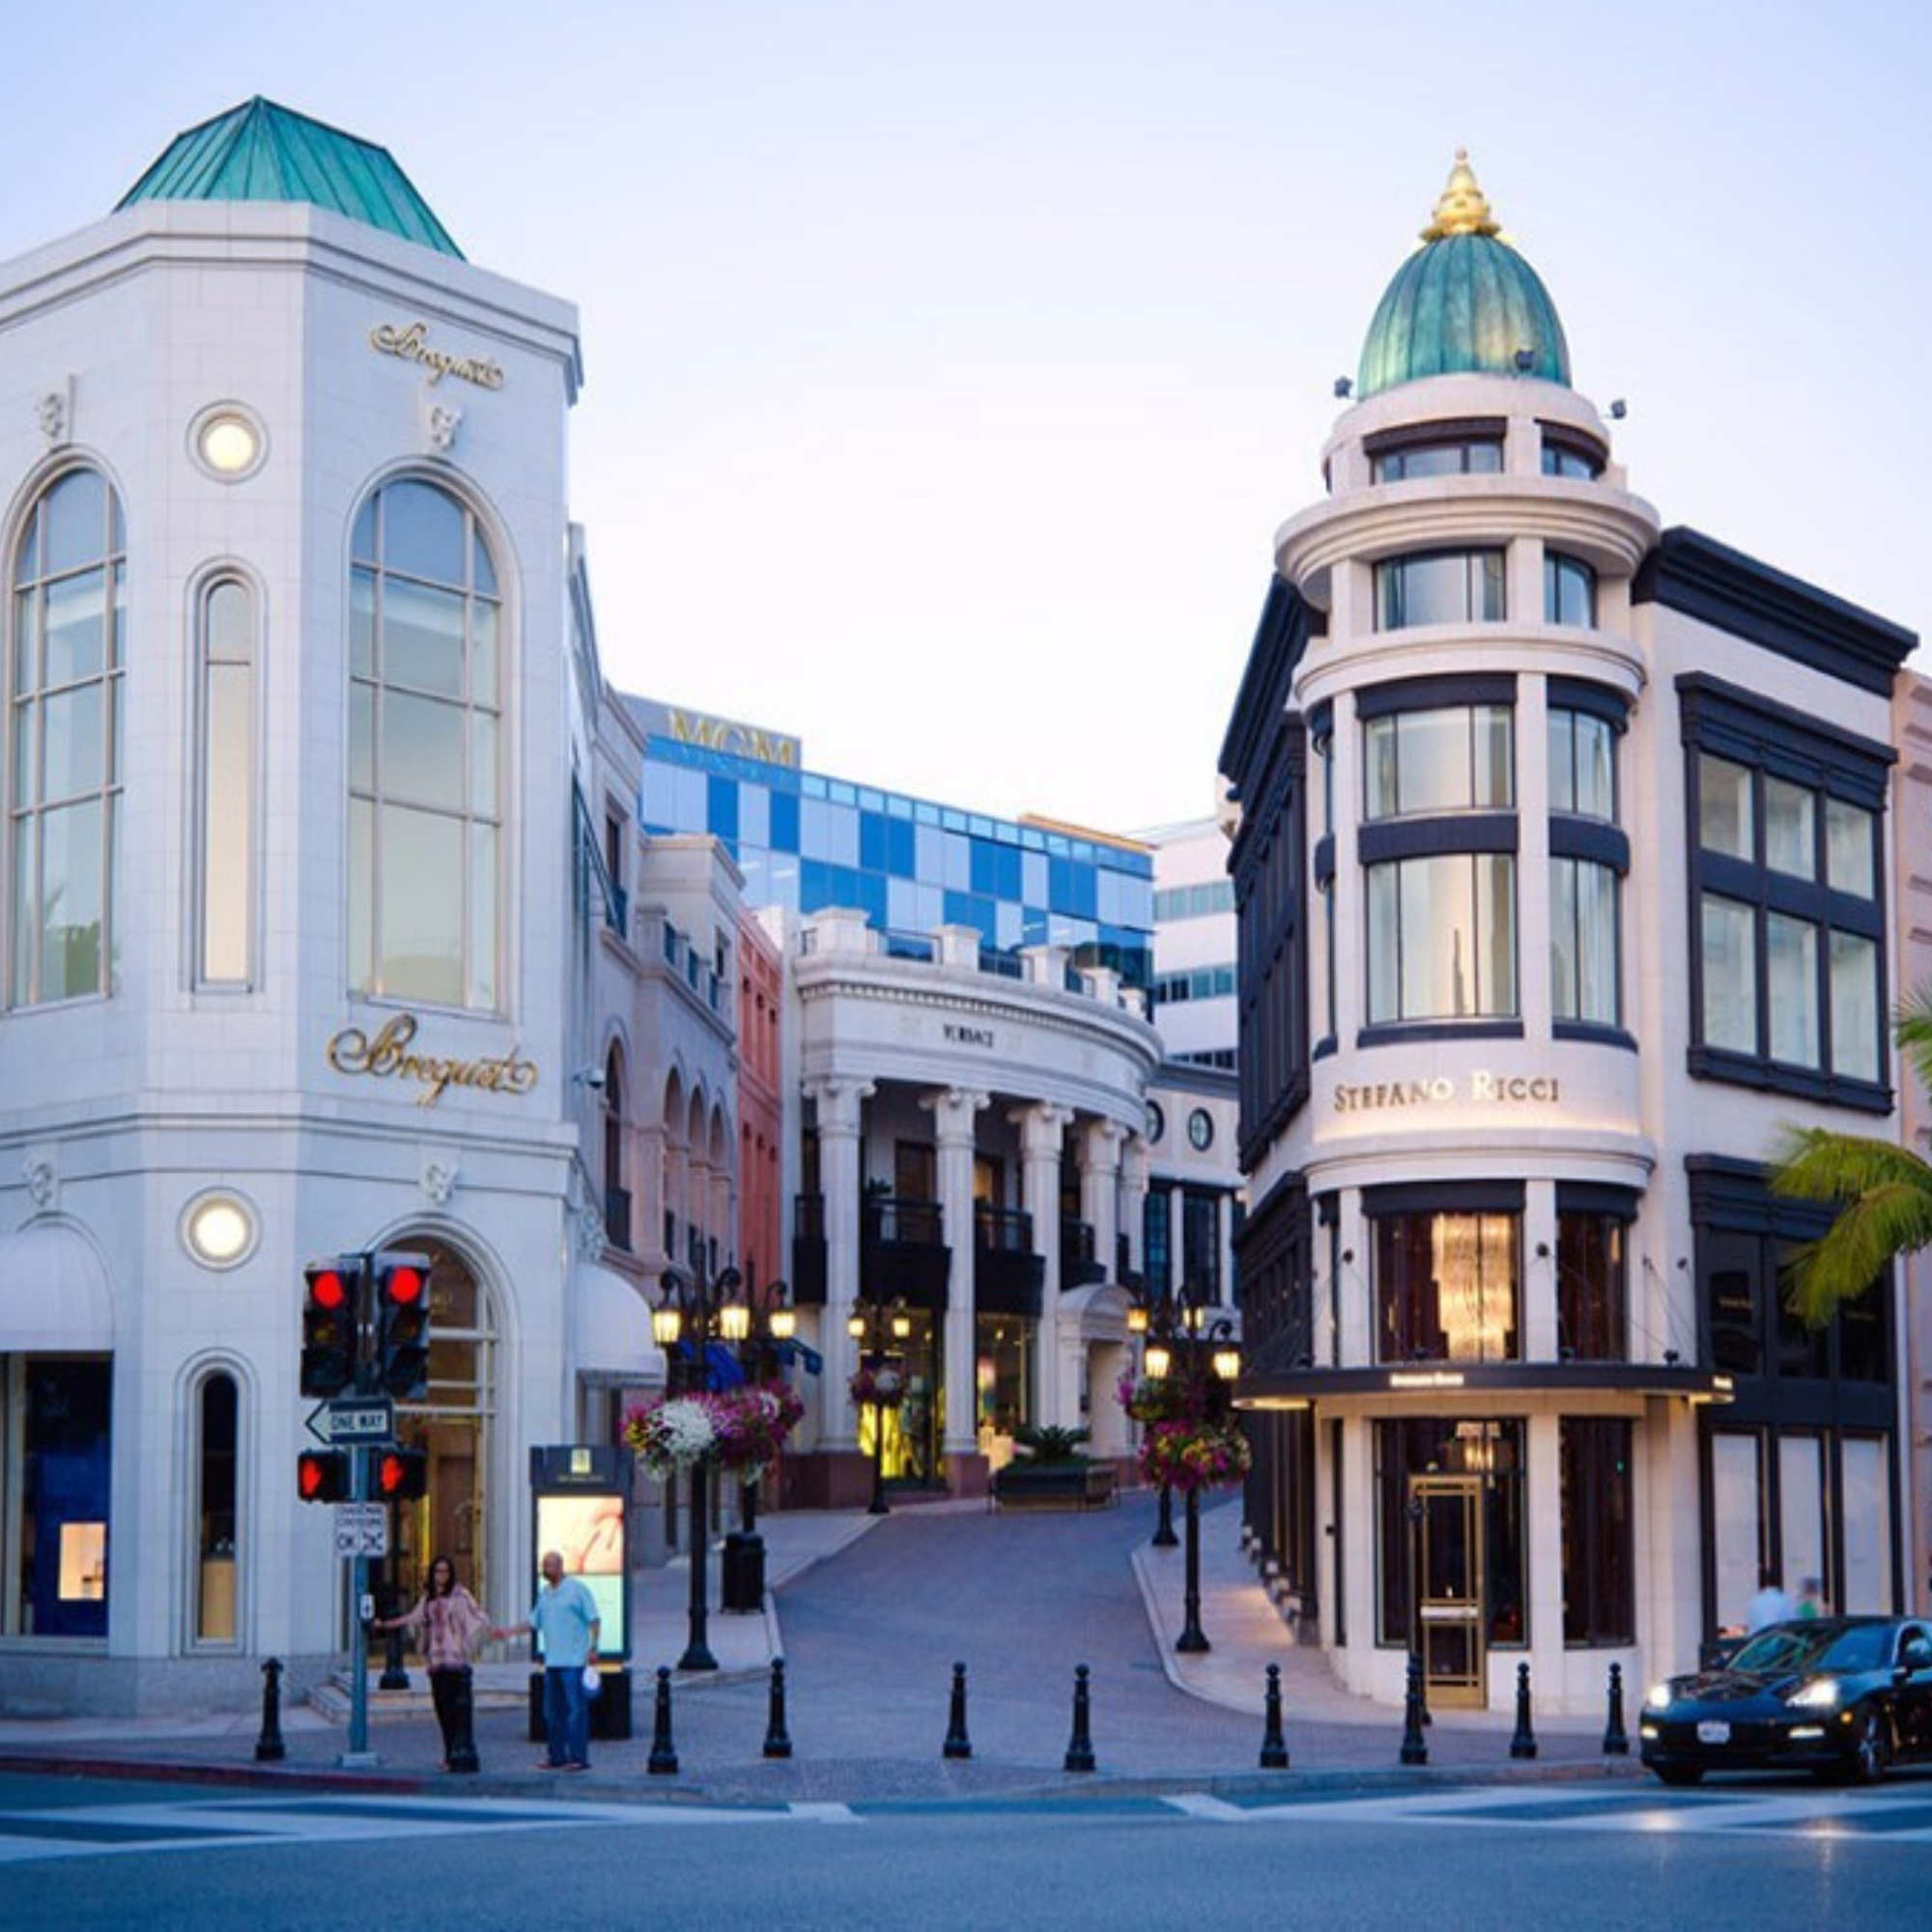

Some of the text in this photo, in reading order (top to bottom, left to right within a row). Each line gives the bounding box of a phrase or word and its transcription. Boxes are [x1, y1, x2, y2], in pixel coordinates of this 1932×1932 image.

[668, 709, 793, 766] MGM
[1333, 1068, 1559, 1114] STEFANO RICCI
[331, 1413, 384, 1430] ONE WAY
